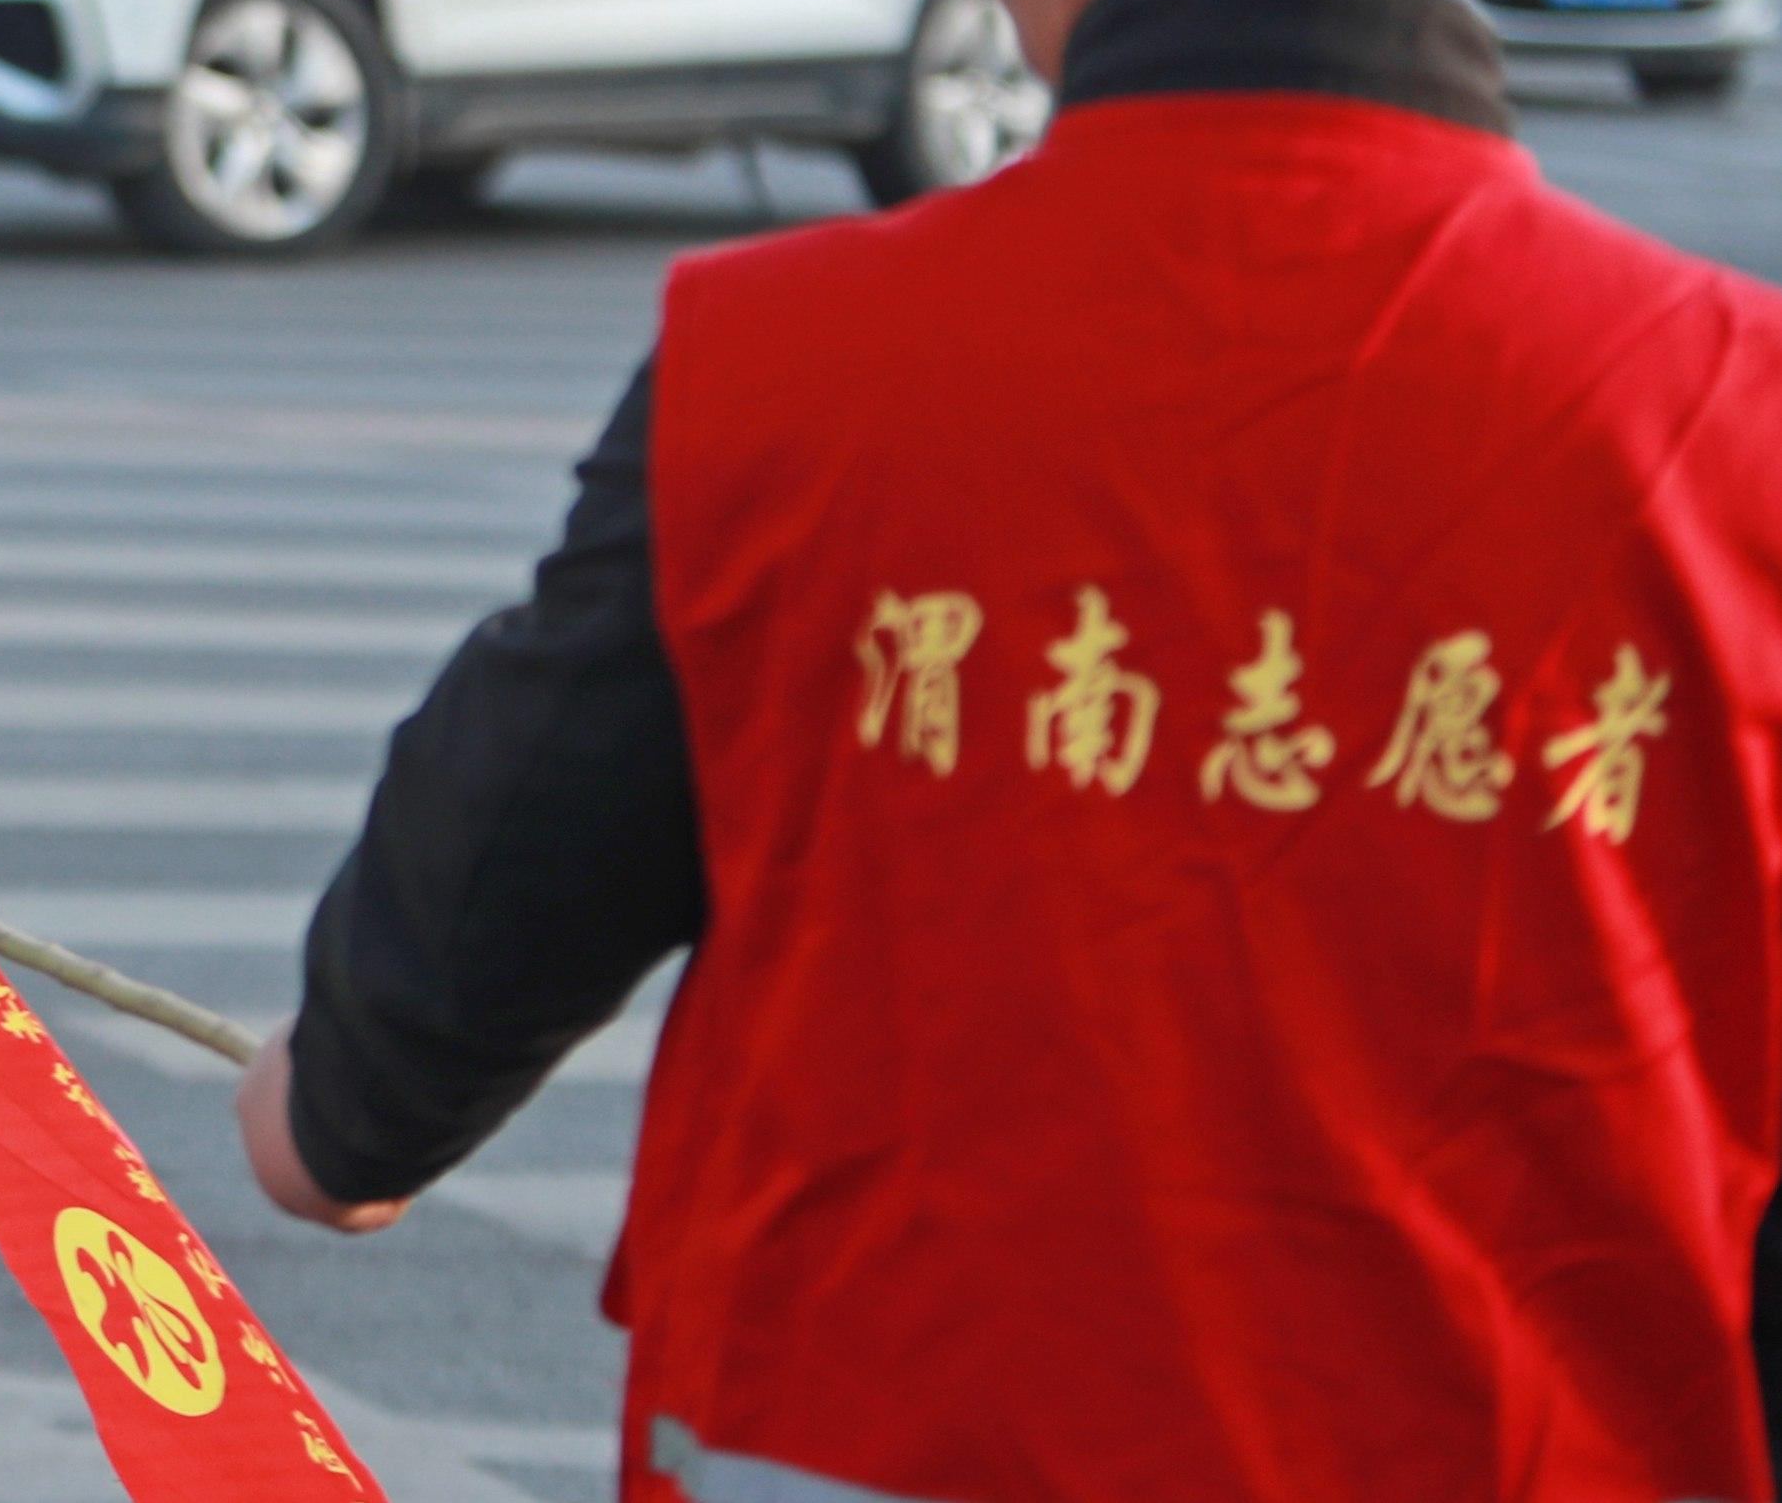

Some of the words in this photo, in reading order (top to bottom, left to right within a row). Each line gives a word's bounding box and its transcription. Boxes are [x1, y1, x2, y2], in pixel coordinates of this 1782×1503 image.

[856, 584, 1671, 845] 渭南志愿者
